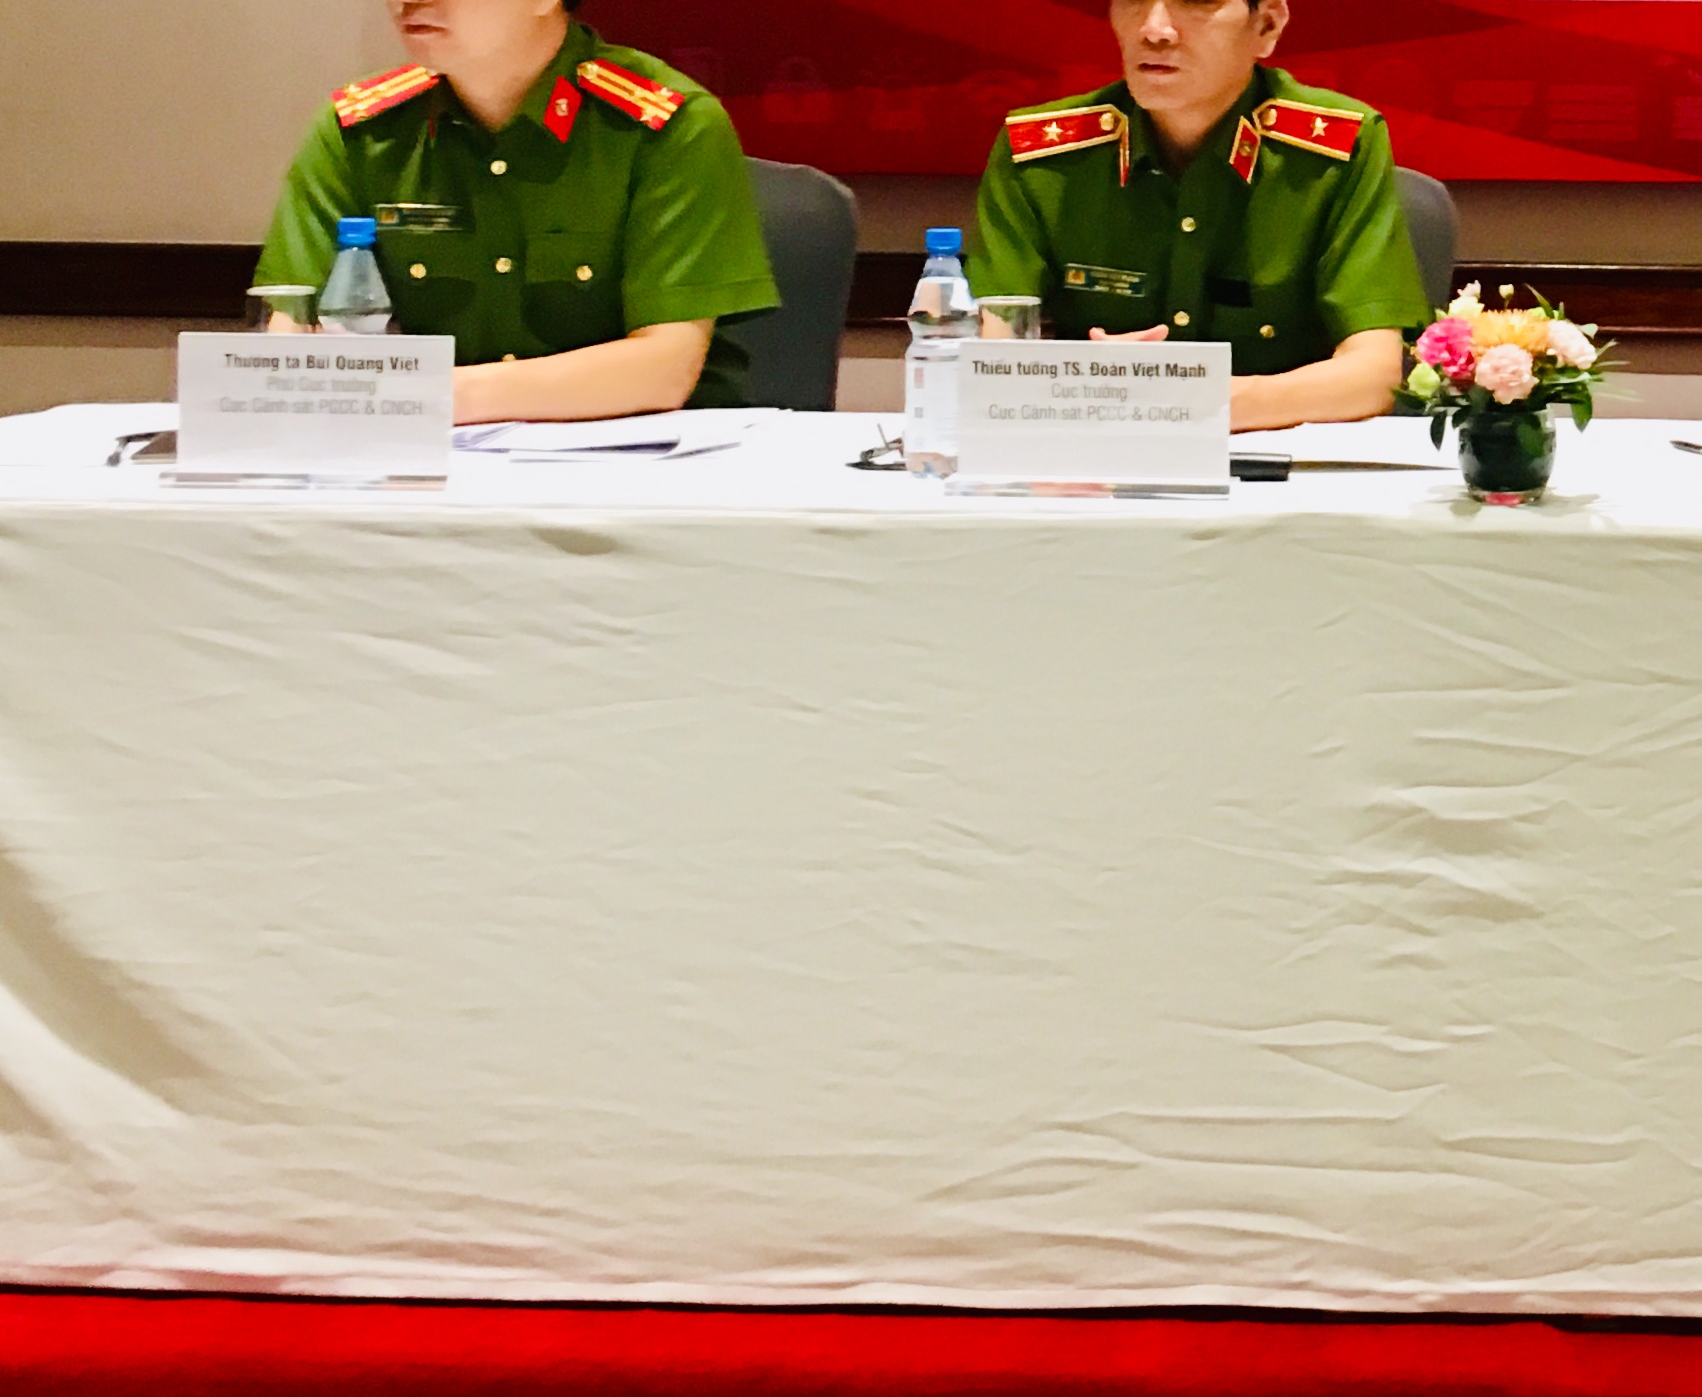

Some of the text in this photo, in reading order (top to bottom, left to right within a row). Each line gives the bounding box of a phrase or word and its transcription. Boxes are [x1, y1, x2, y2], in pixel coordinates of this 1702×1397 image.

[336, 355, 384, 374] Quang
[1062, 361, 1085, 376] TS.
[1087, 405, 1127, 421] PCCC
[1131, 405, 1143, 421] &
[1147, 405, 1190, 422] CNCH
